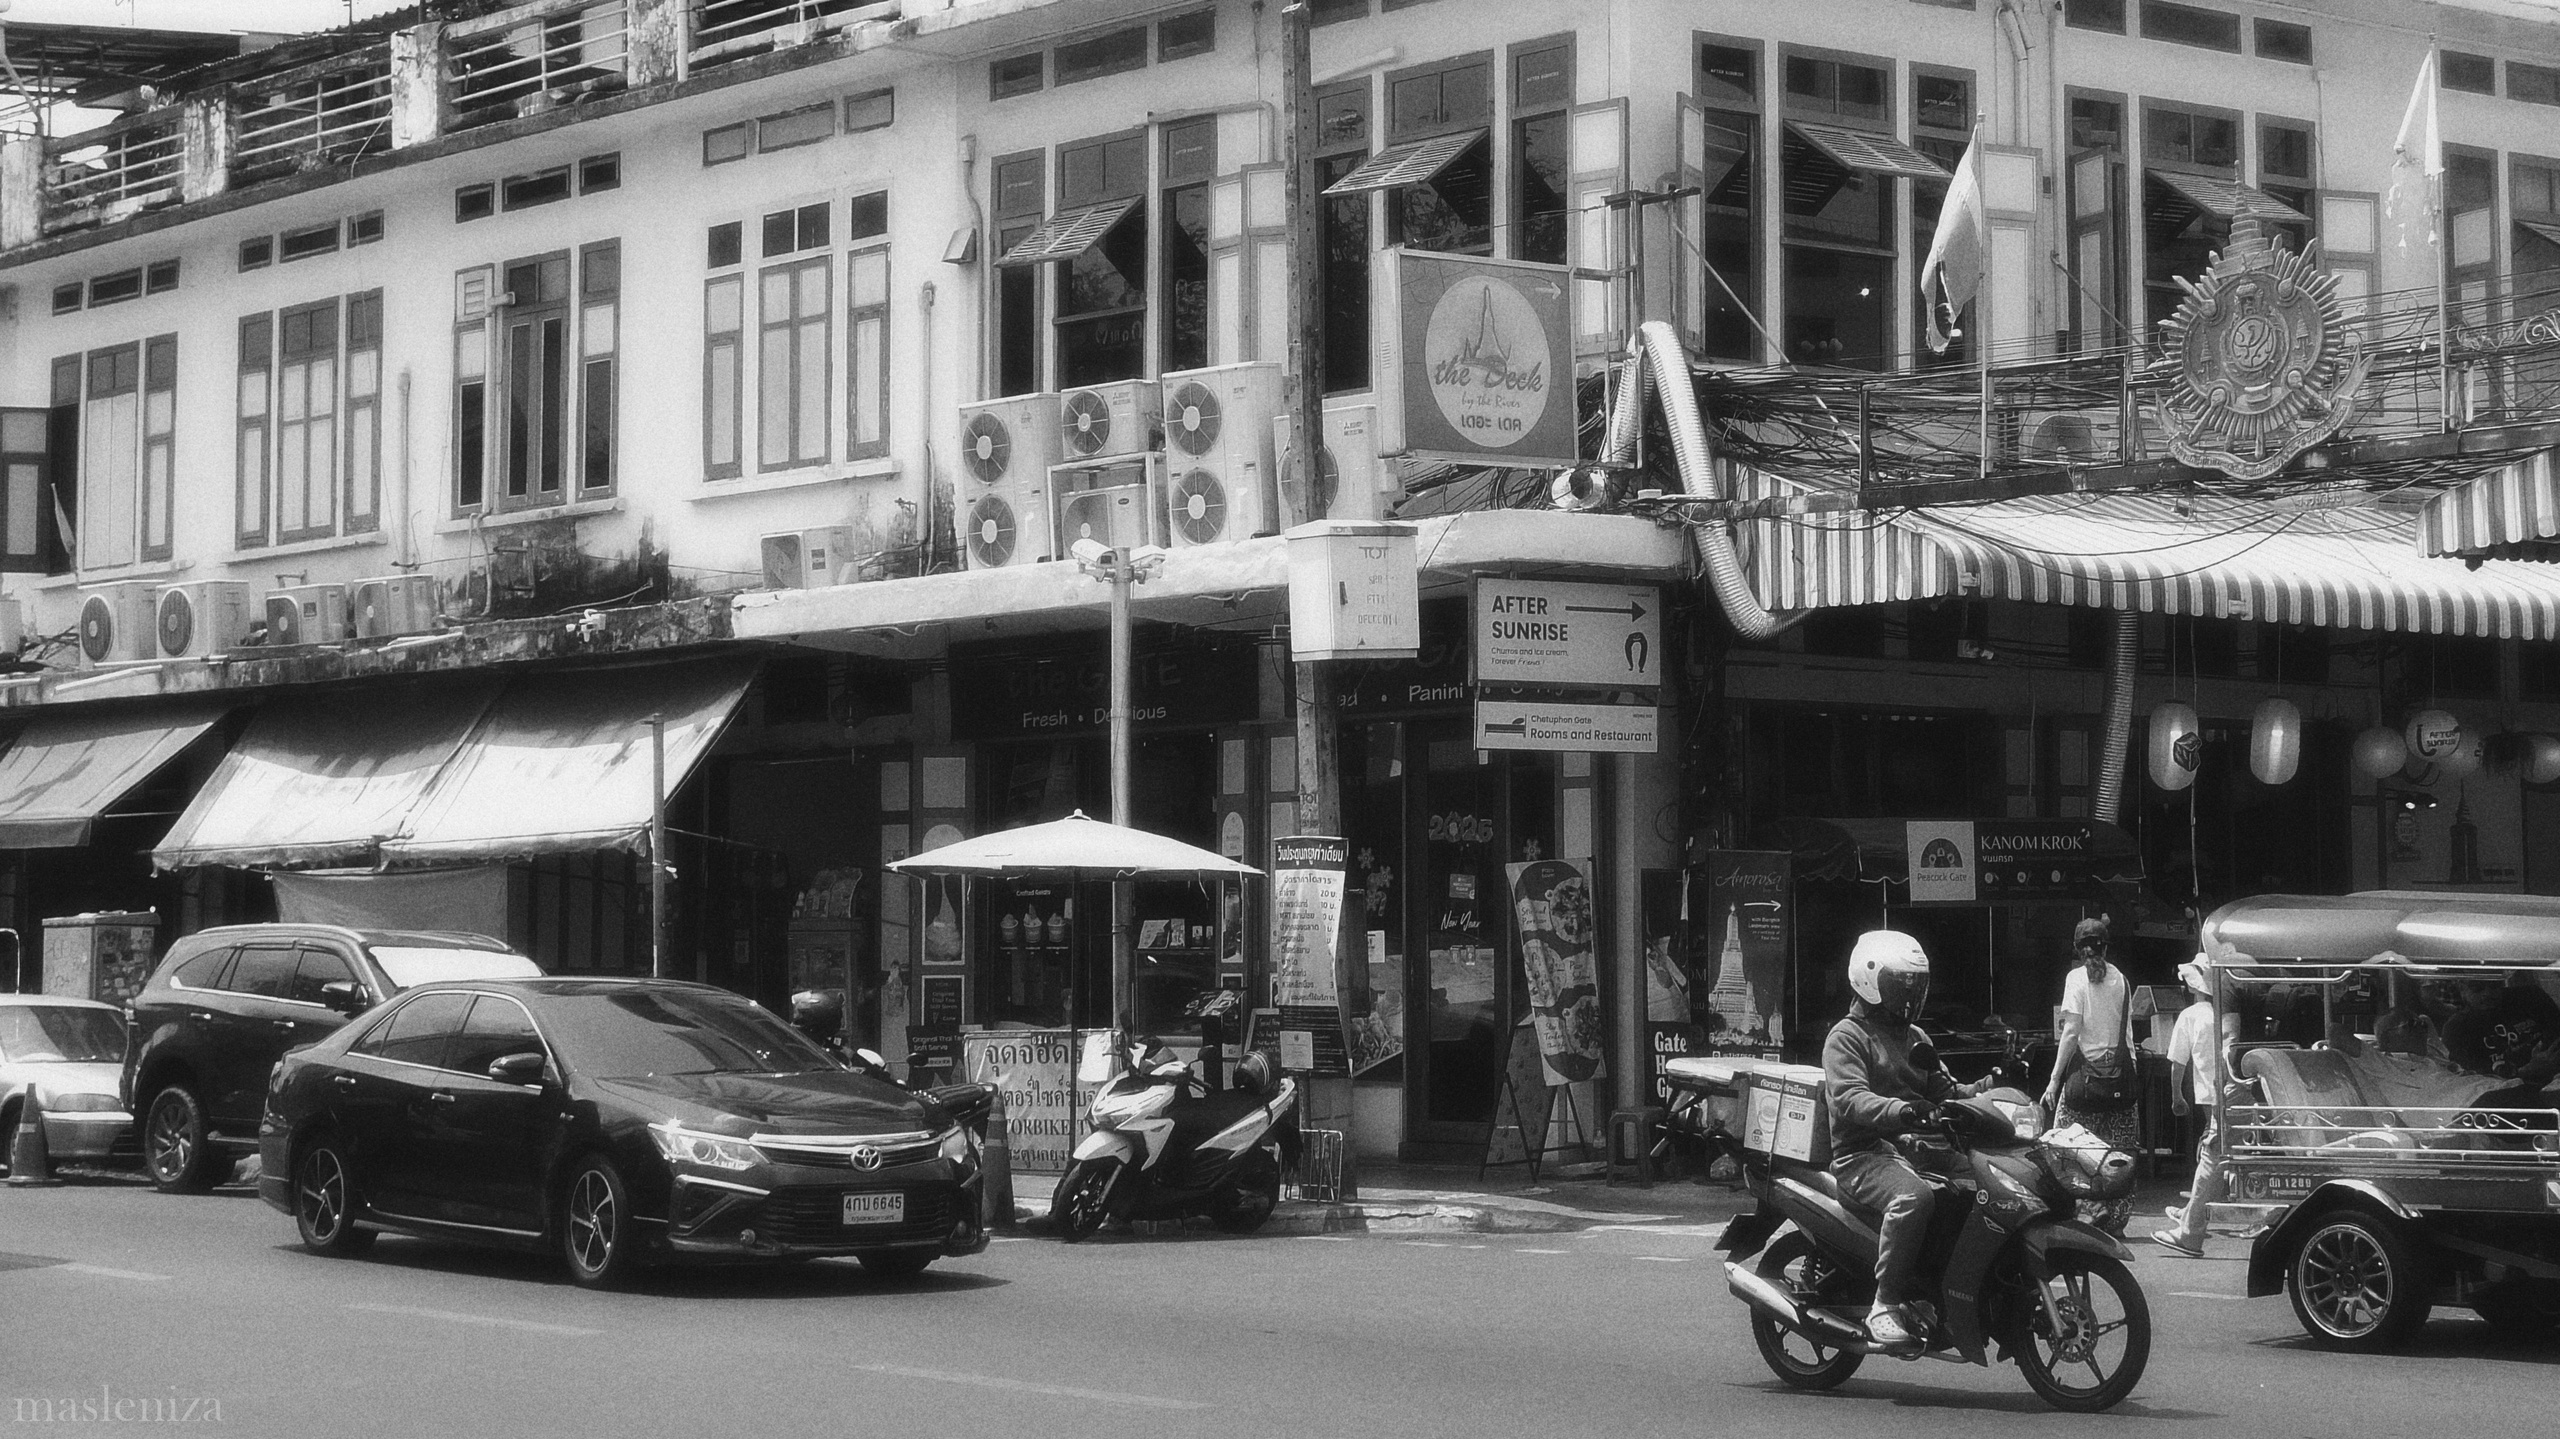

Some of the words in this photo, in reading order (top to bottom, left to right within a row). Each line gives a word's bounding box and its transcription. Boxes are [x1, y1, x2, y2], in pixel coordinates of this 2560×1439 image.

[1434, 355, 1471, 386] the
[1484, 360, 1544, 392] Deck
[1461, 414, 1492, 429] เดอะ
[1498, 417, 1522, 432] เดค
[1359, 547, 1391, 559] TOT
[1491, 595, 1548, 615] AFTER
[1491, 621, 1568, 641] SUNRISE
[1491, 647, 1518, 655] Churros
[1409, 682, 1463, 702] Panini
[1023, 709, 1068, 728] Fresh
[1574, 716, 1592, 724] Gate
[1530, 728, 1568, 739] Rooms
[1570, 729, 1592, 740] and
[1594, 730, 1652, 742] Restaurant
[1981, 836, 2038, 850] KANOM
[2041, 836, 2084, 850] KROK
[1715, 866, 1782, 891] Amorosa
[1917, 872, 1948, 882] Peacock
[1950, 872, 1967, 881] Gate
[1440, 910, 1458, 930] New
[1460, 910, 1481, 931] Year
[912, 1036, 938, 1045] Original
[1654, 1031, 1687, 1053] Gate
[873, 1196, 902, 1210] 6645
